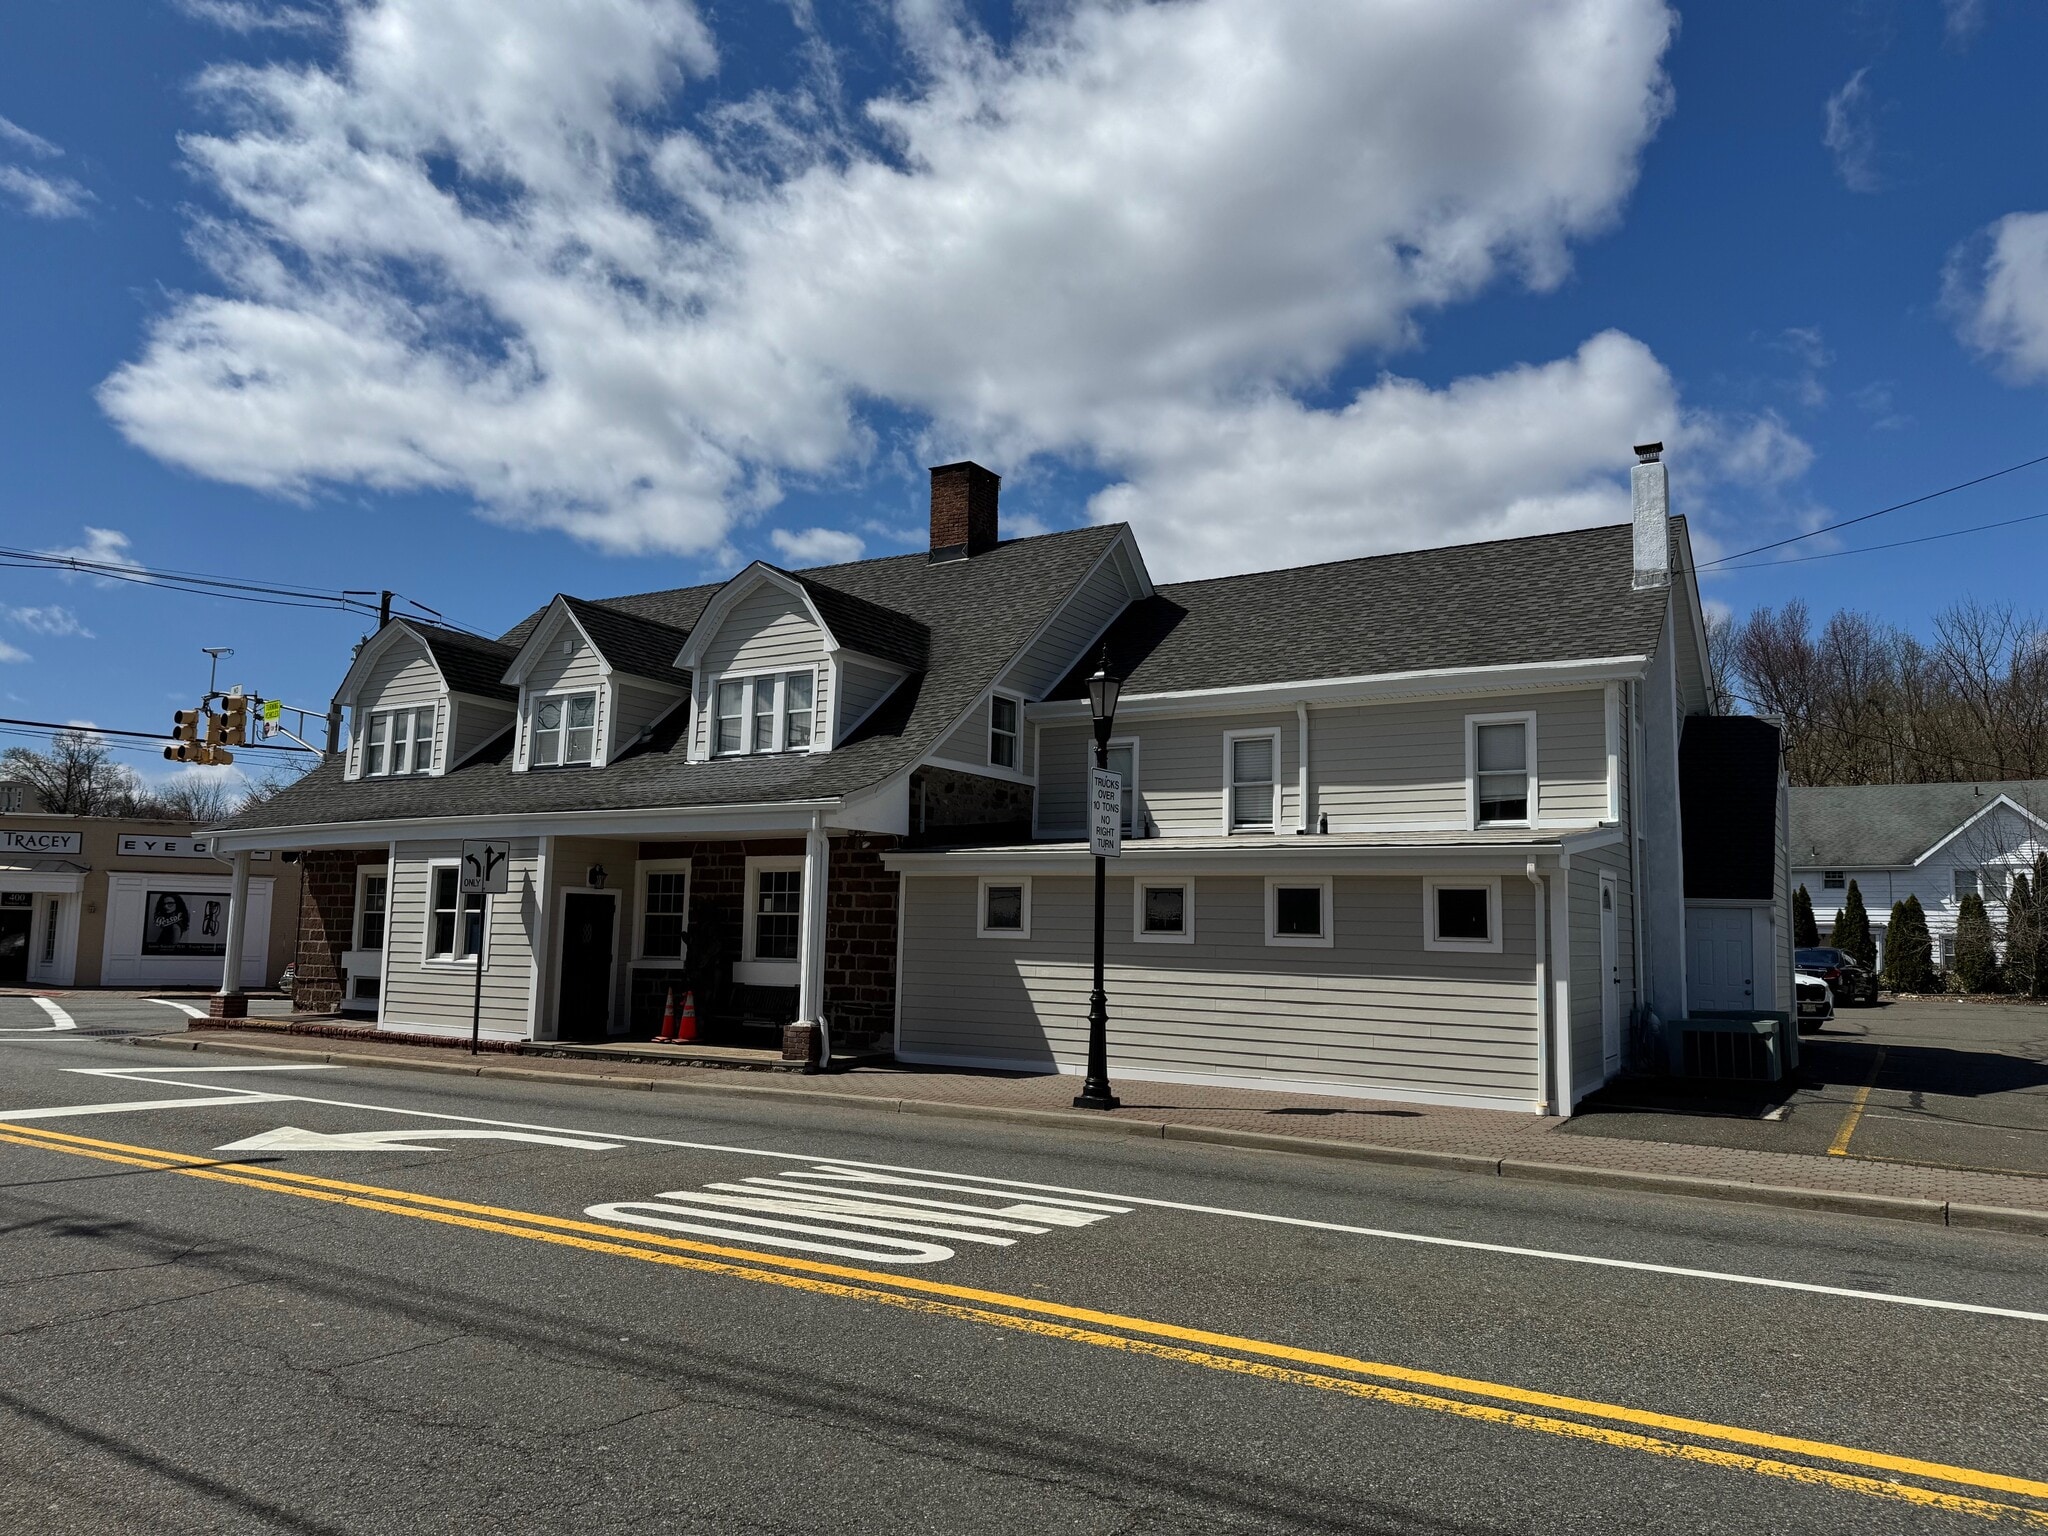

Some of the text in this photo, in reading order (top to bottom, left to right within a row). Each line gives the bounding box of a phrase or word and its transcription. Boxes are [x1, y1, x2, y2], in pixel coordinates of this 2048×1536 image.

[1094, 776, 1120, 790] TRUCKS
[1098, 789, 1115, 801] OVER
[1093, 801, 1120, 814] 10 TONS
[1101, 815, 1111, 825] NO
[1096, 826, 1115, 838] RIGHT
[4, 832, 71, 851] TRACEY
[124, 840, 177, 851] EYE
[1097, 838, 1114, 849] TURN
[464, 878, 481, 888] ONLY
[584, 1165, 1136, 1265] ONLY
